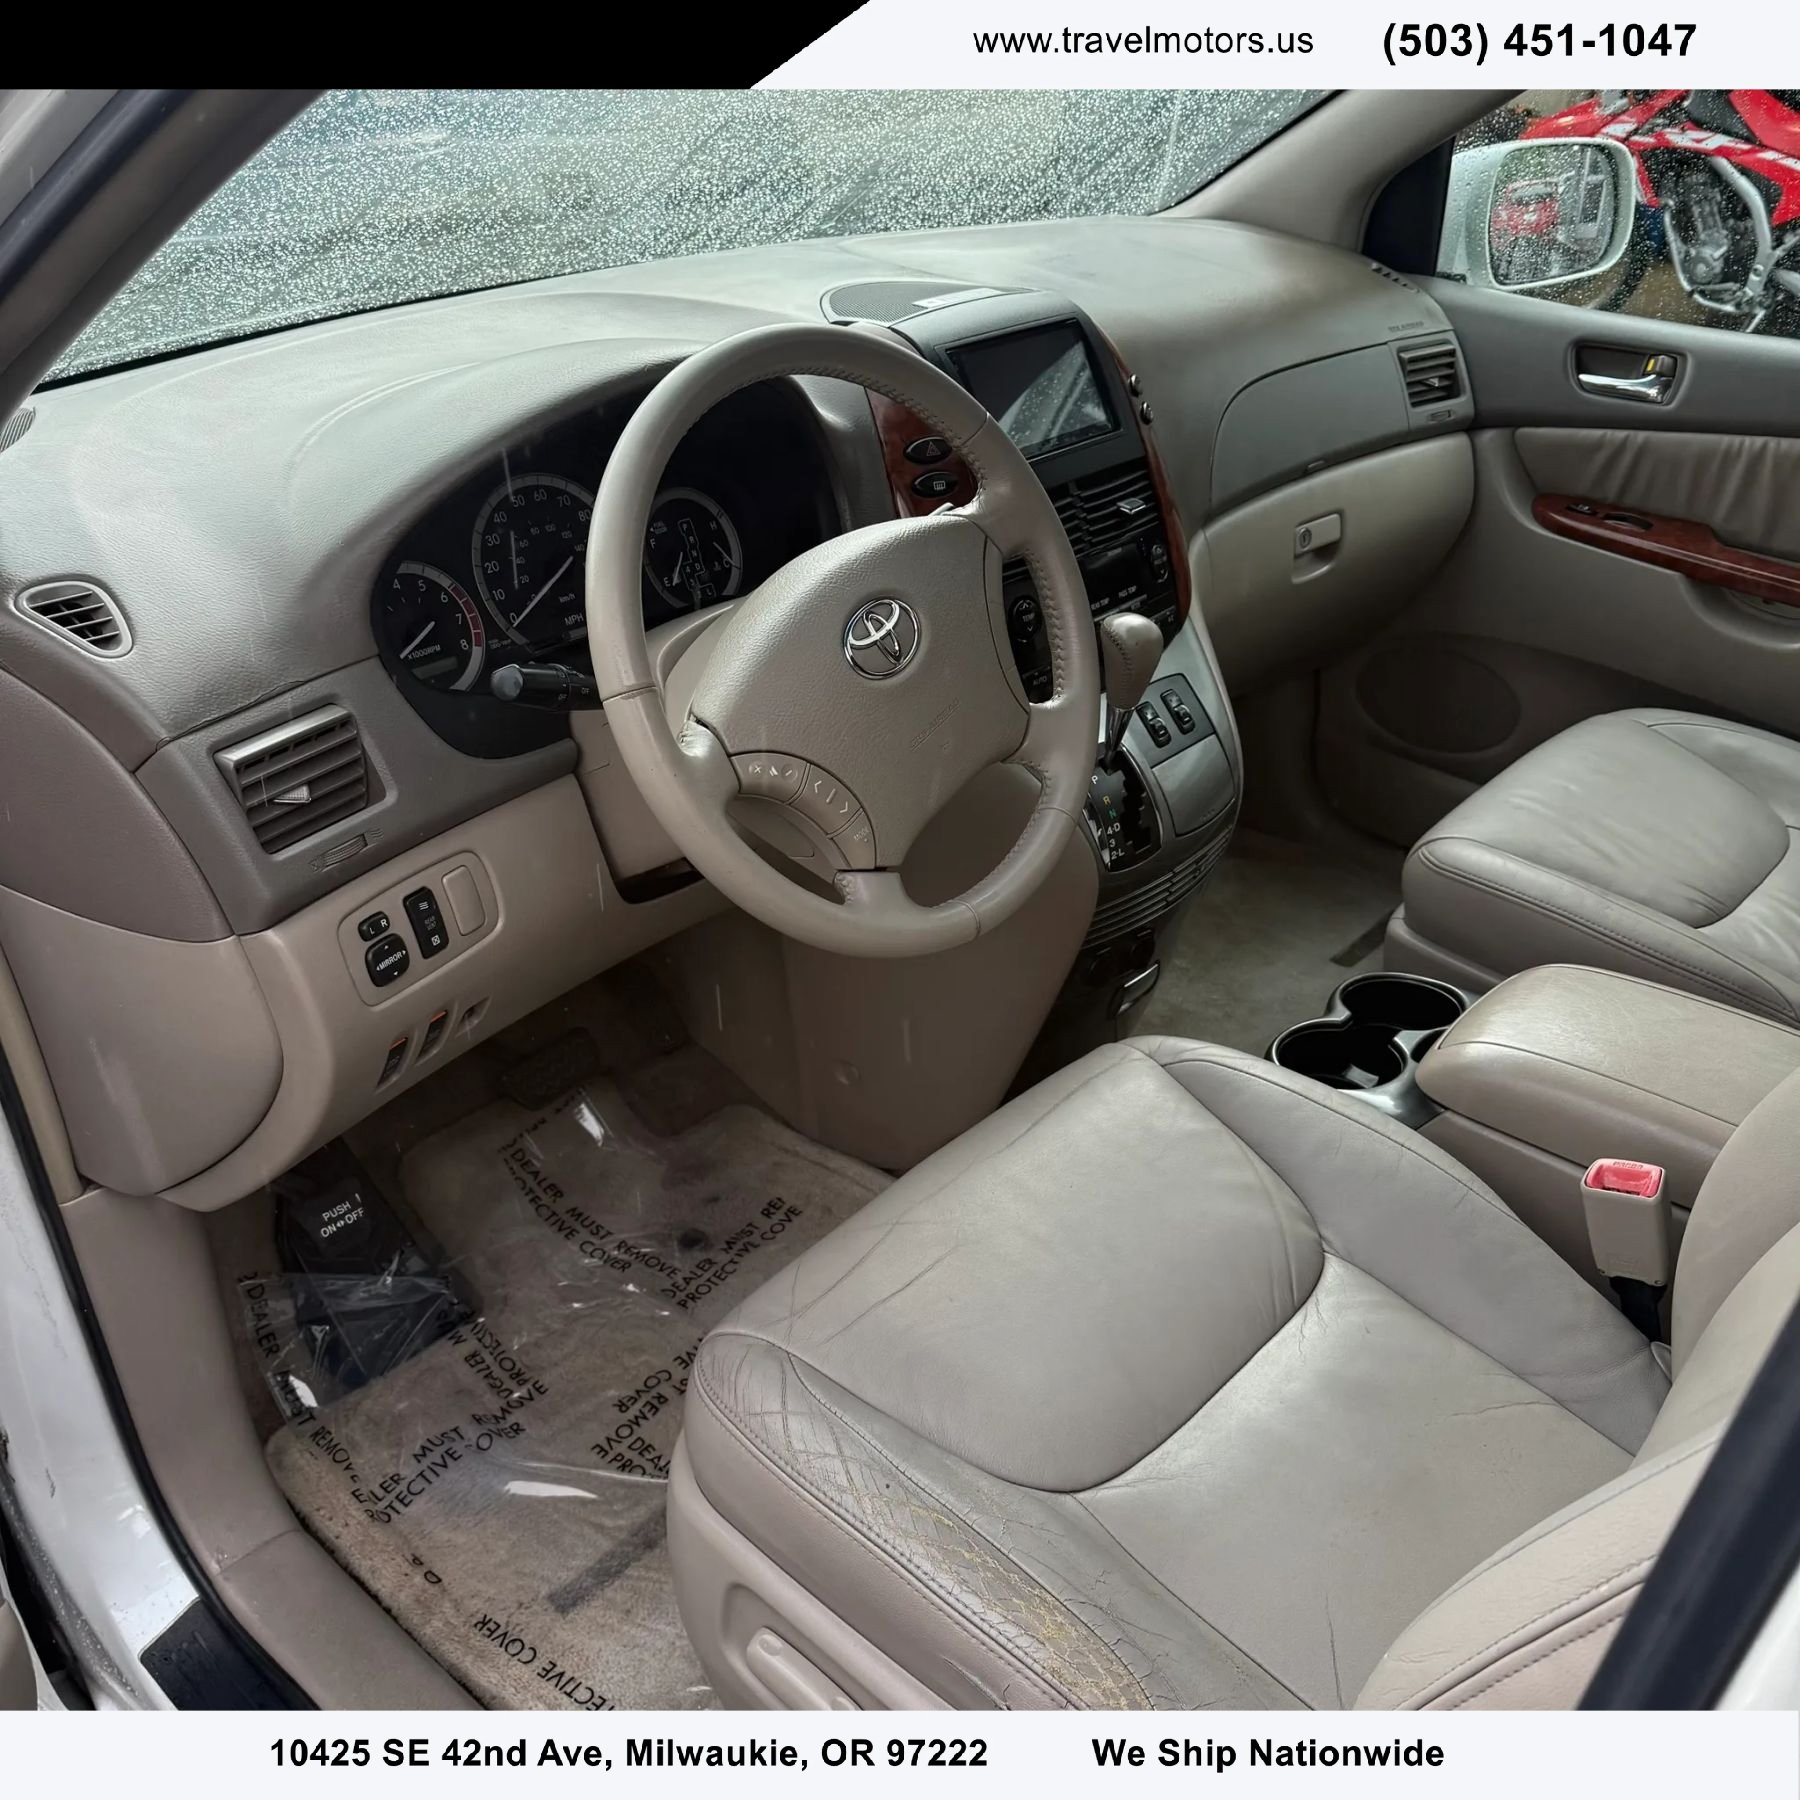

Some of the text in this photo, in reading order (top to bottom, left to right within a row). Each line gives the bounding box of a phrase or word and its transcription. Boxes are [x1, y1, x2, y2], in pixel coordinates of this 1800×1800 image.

[513, 495, 525, 507] 50
[534, 489, 547, 501] 60
[558, 495, 571, 507] 70
[493, 512, 507, 523] 40
[578, 509, 591, 522] 80
[485, 534, 500, 546] 30
[484, 561, 499, 573] 20
[392, 578, 401, 590] 4
[418, 579, 426, 592] 5
[440, 591, 449, 603] 6
[492, 588, 505, 601] 10
[455, 613, 463, 625] 7
[564, 612, 584, 626] MPH
[460, 639, 469, 650] 8
[1090, 775, 1099, 785] P
[1103, 795, 1111, 805] R
[1109, 809, 1118, 819] N
[1109, 838, 1116, 848] 3
[369, 918, 388, 936] L R
[379, 950, 403, 970] MIRROR
[322, 1200, 352, 1222] PUSH
[510, 1150, 682, 1280] DEALER MUST REMOVE
[320, 1207, 365, 1239] ON OFF
[579, 1240, 633, 1274] COVER
[246, 1283, 281, 1359] DEALER
[464, 1350, 514, 1400] DEALER
[612, 1368, 673, 1414] COVER
[412, 1425, 466, 1464] MUST
[471, 1378, 550, 1427] REMOVE
[590, 1392, 669, 1460] REMOVE
[464, 1421, 528, 1453] OVER
[473, 1613, 615, 1711] COVER ECTIVE
